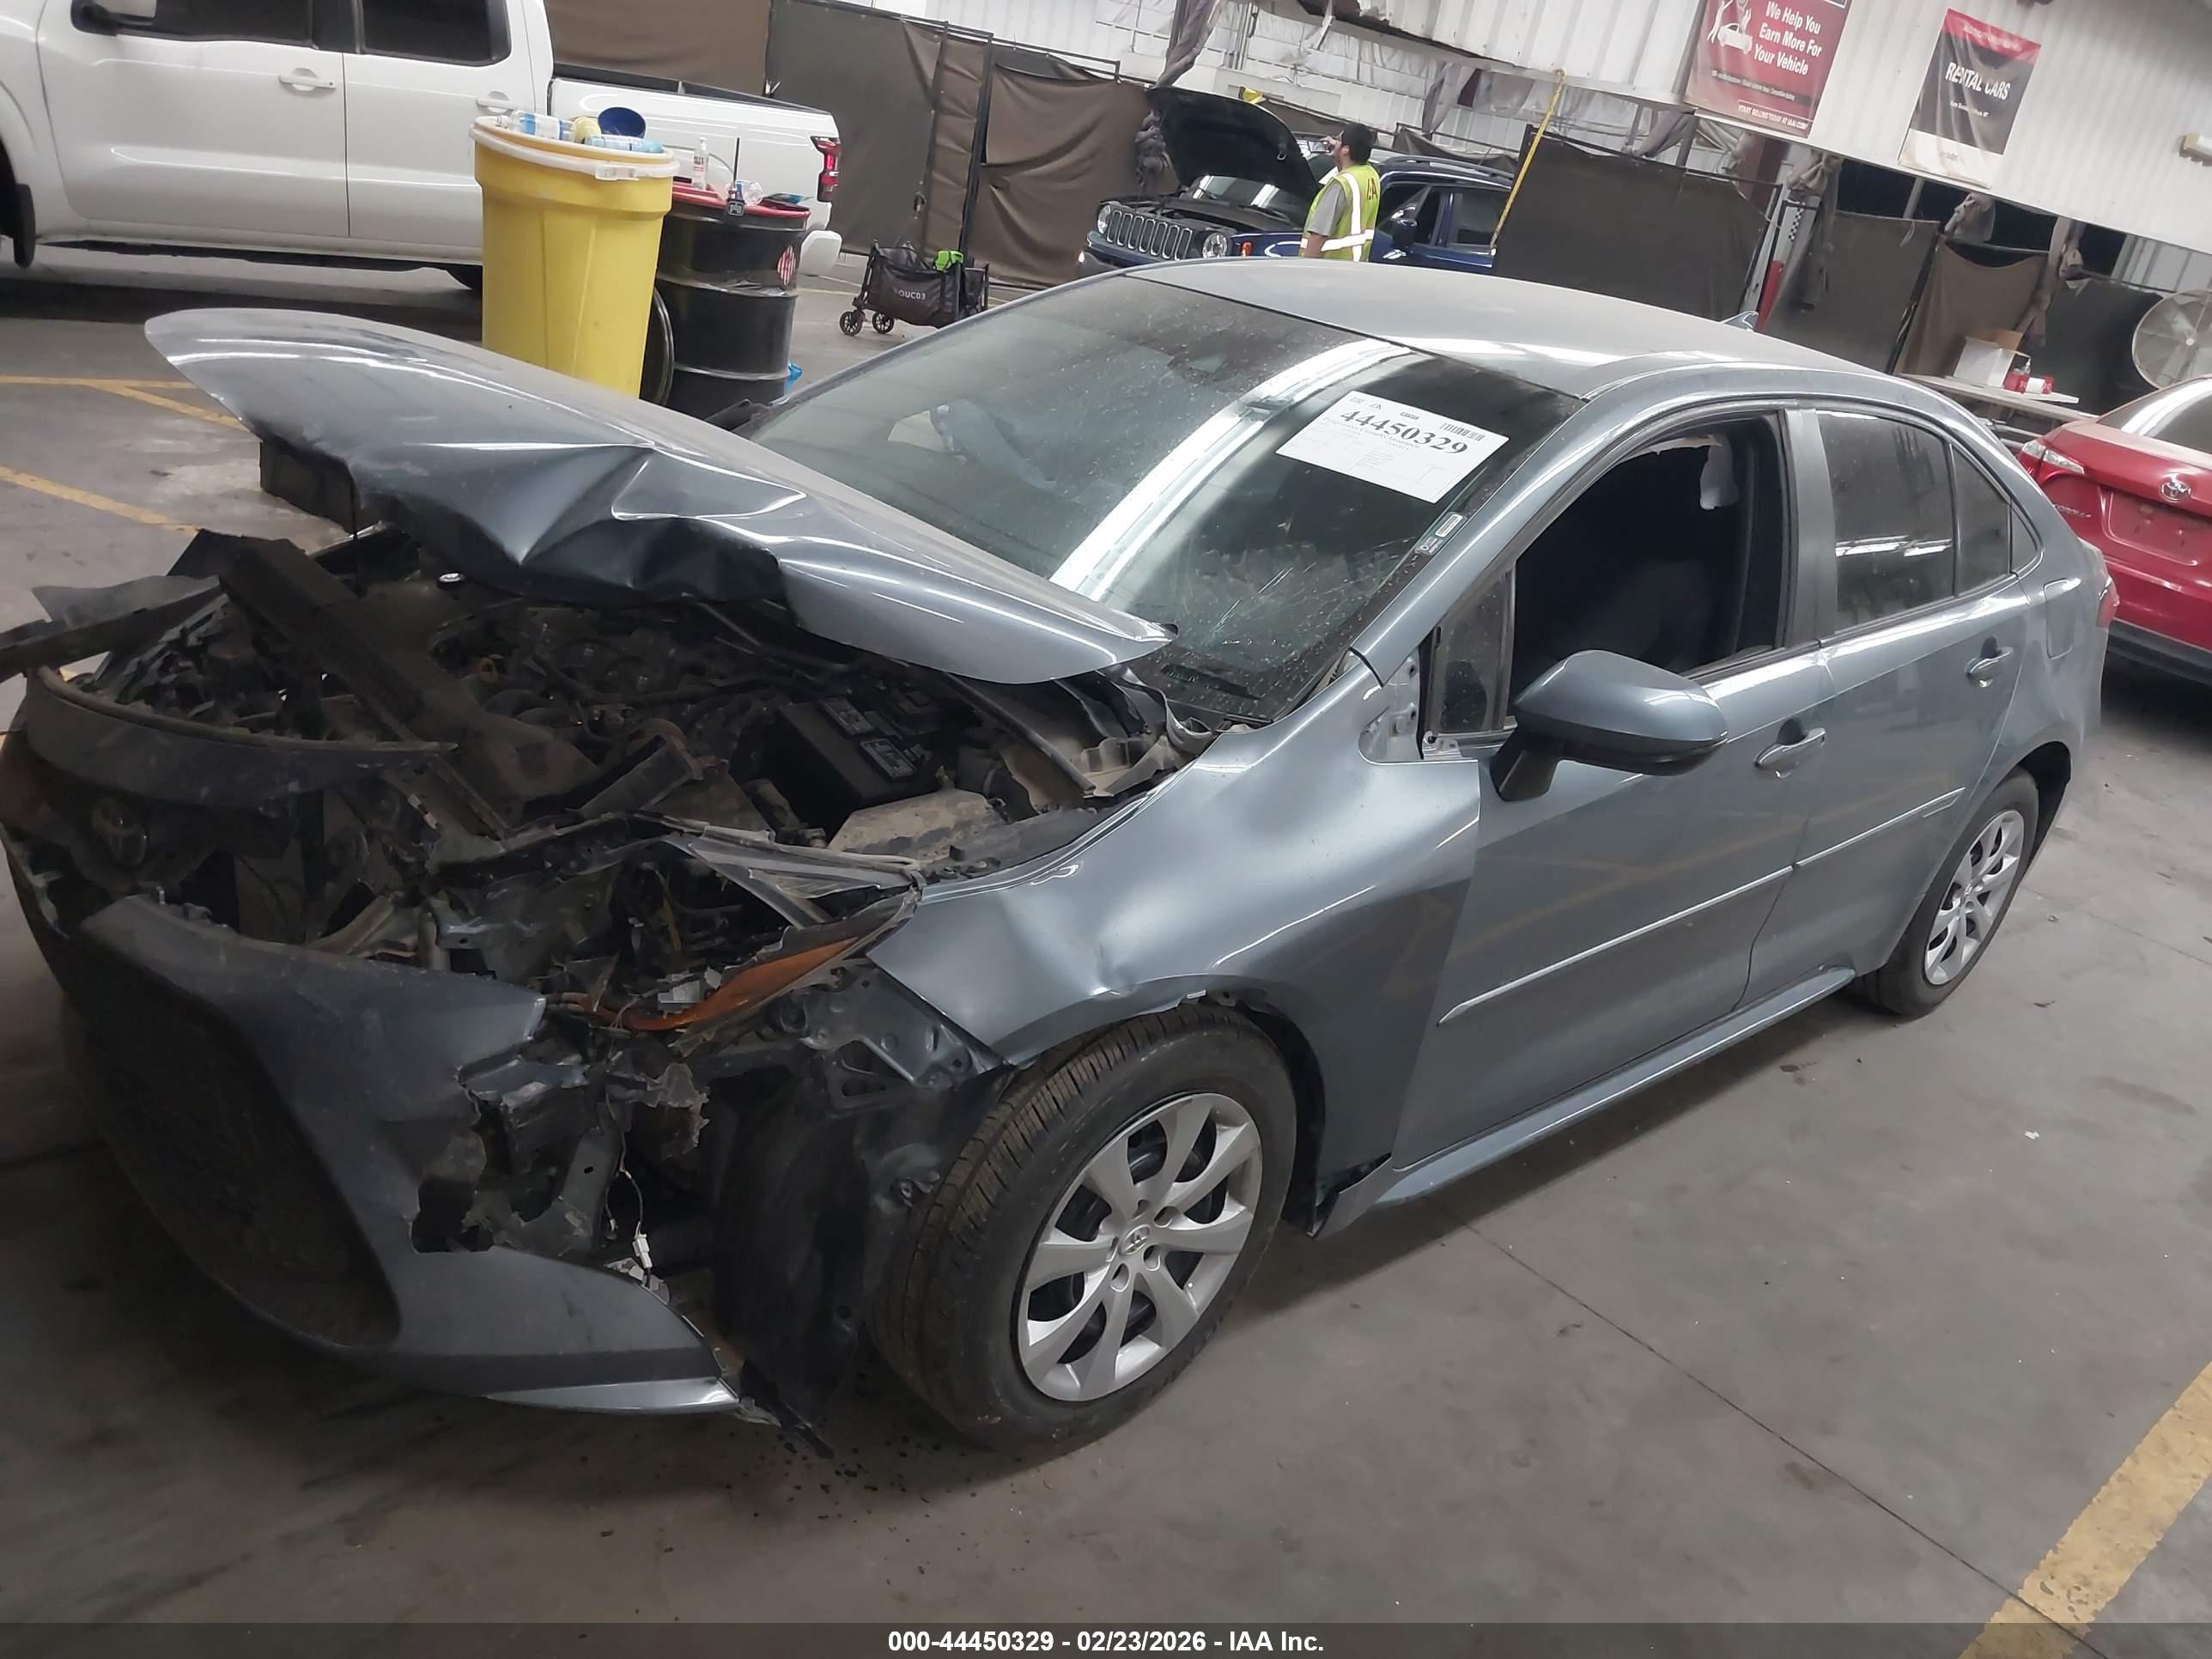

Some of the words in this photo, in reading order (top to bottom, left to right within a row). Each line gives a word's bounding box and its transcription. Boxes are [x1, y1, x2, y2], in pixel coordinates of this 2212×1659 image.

[1765, 1, 1781, 20] We
[1782, 7, 1803, 31] Help
[1804, 15, 1821, 35] You
[1759, 22, 1781, 41] Earn
[1782, 30, 1806, 52] More
[1807, 40, 1822, 58] For
[1753, 44, 1776, 64] Your
[1777, 52, 1809, 76] Vehicle
[1945, 61, 1983, 92] RENTAL
[1984, 81, 2011, 100] CARS
[1340, 410, 1468, 454] 44450329
